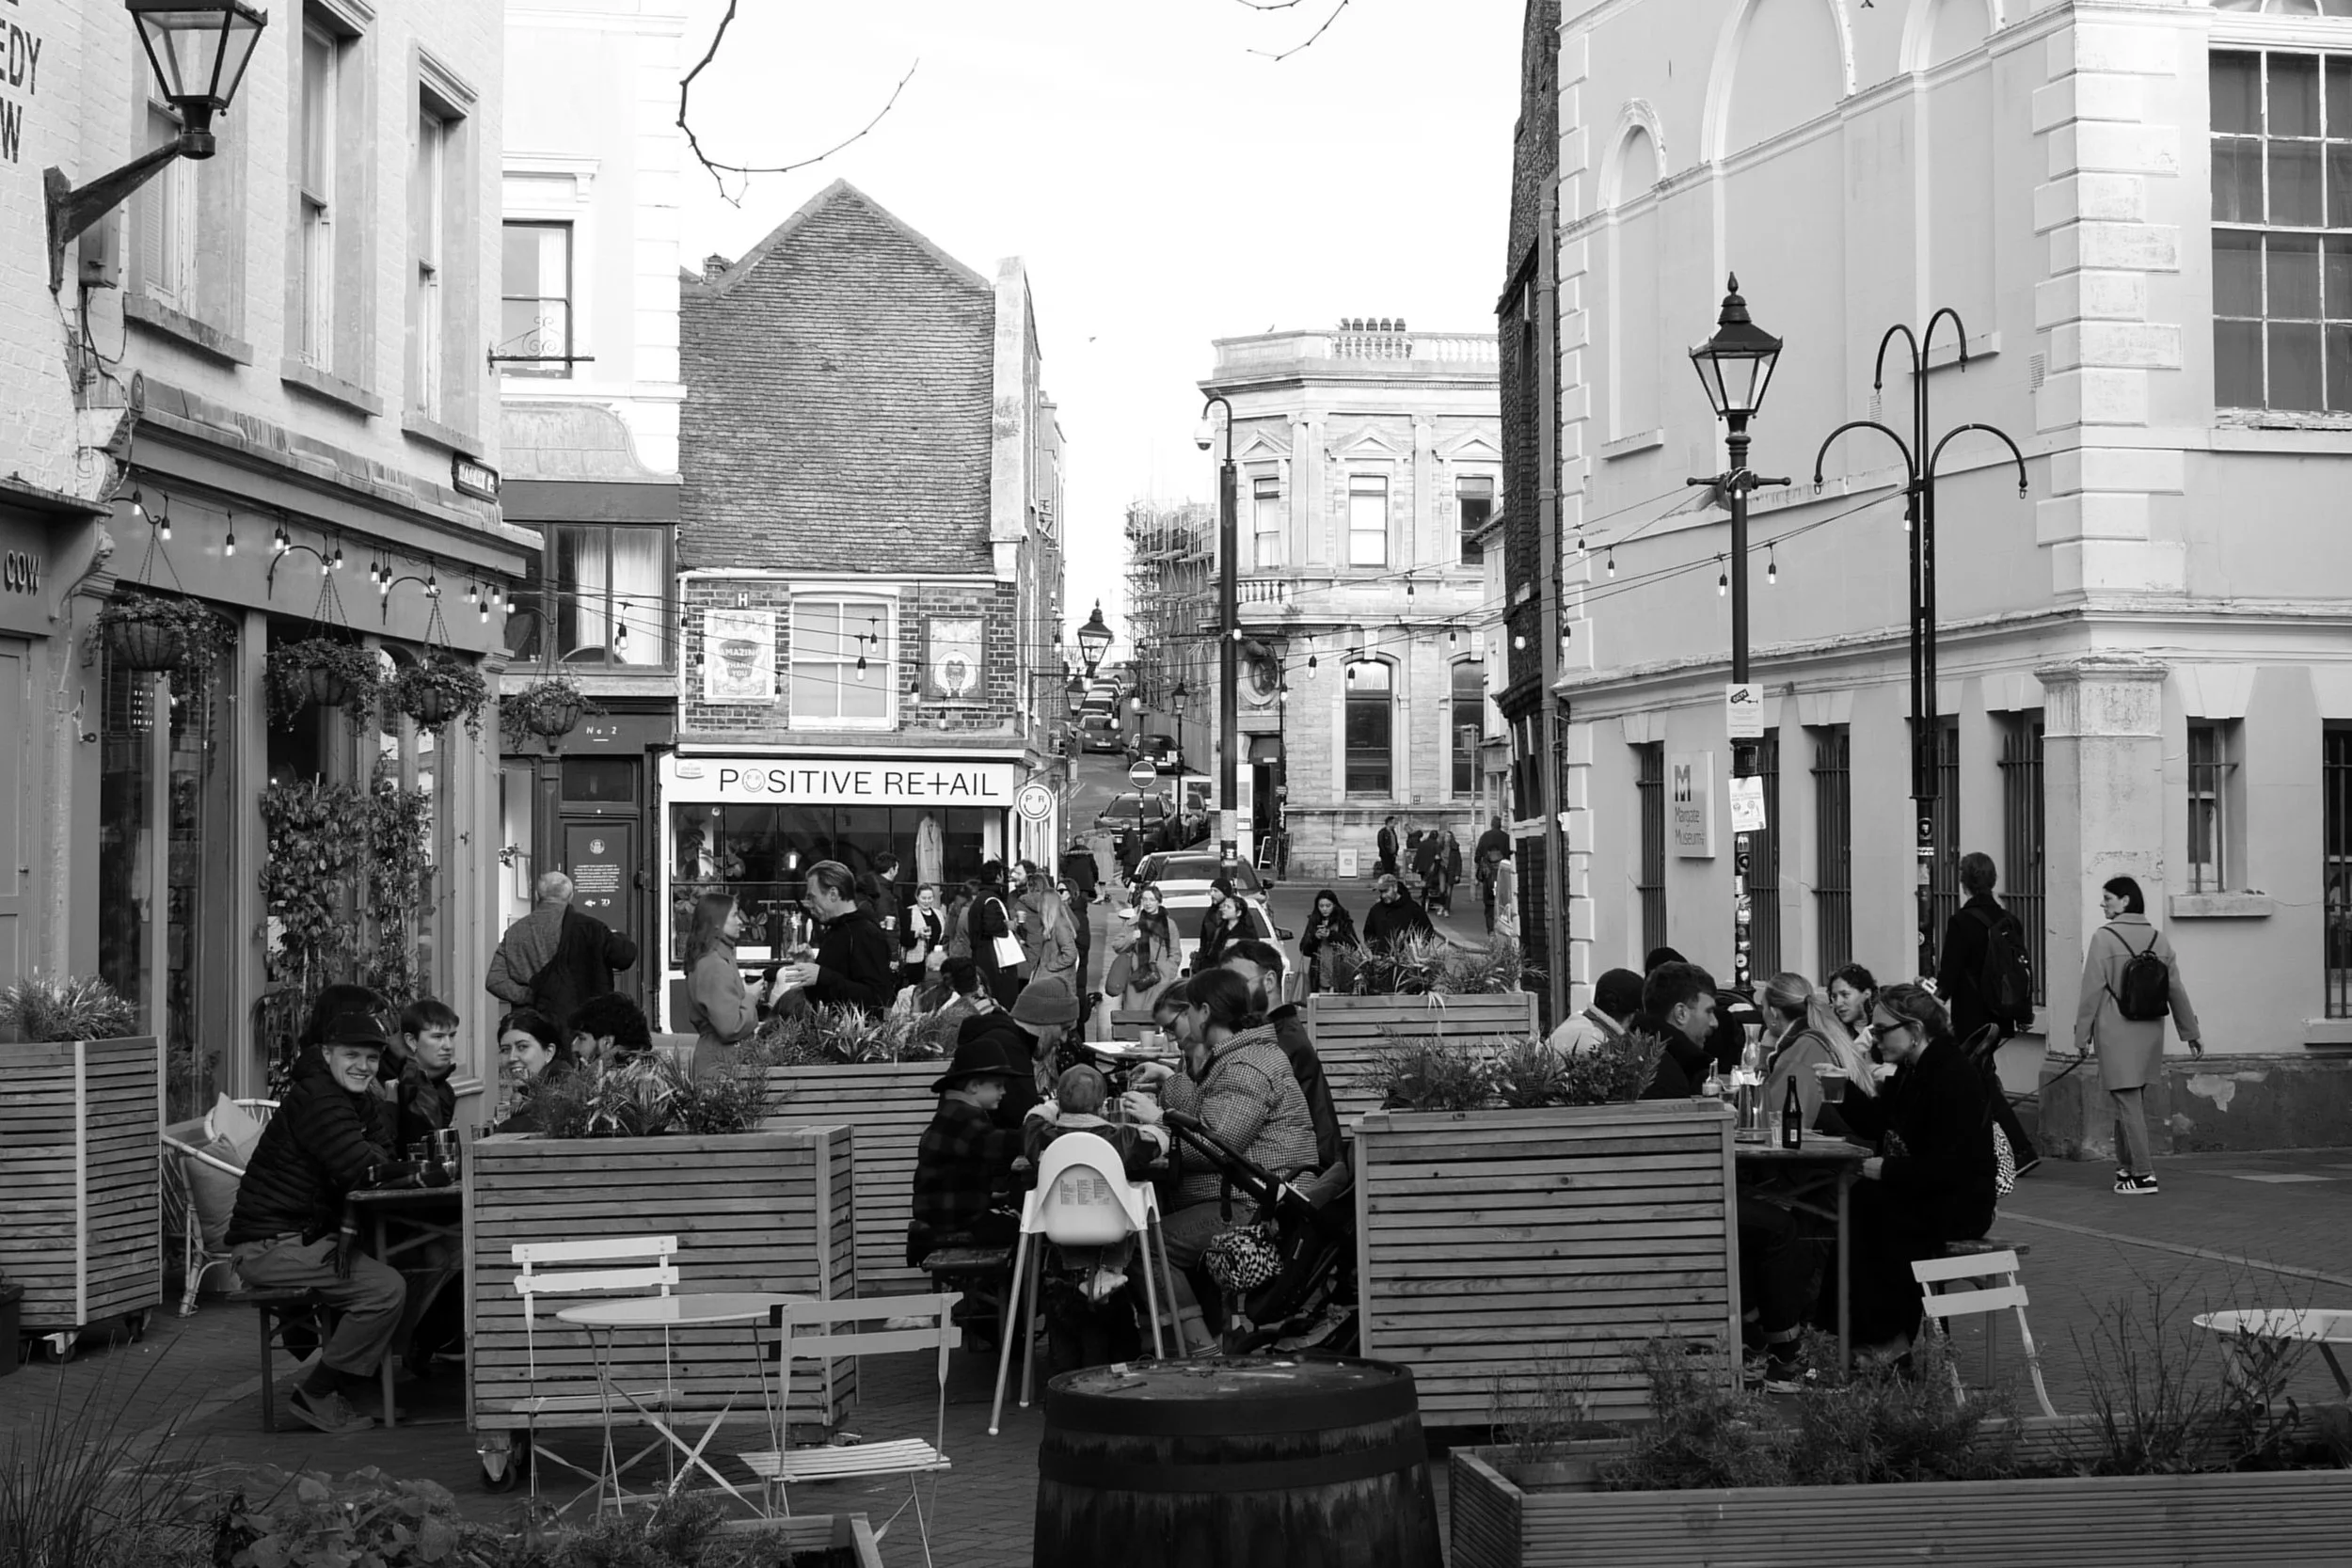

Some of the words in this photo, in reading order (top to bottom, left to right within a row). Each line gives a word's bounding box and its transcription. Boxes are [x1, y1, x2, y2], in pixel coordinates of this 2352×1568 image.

[5, 549, 41, 593] COW
[611, 726, 617, 735] 2
[1675, 806, 1700, 828] Margate
[1675, 828, 1701, 846] Museum
